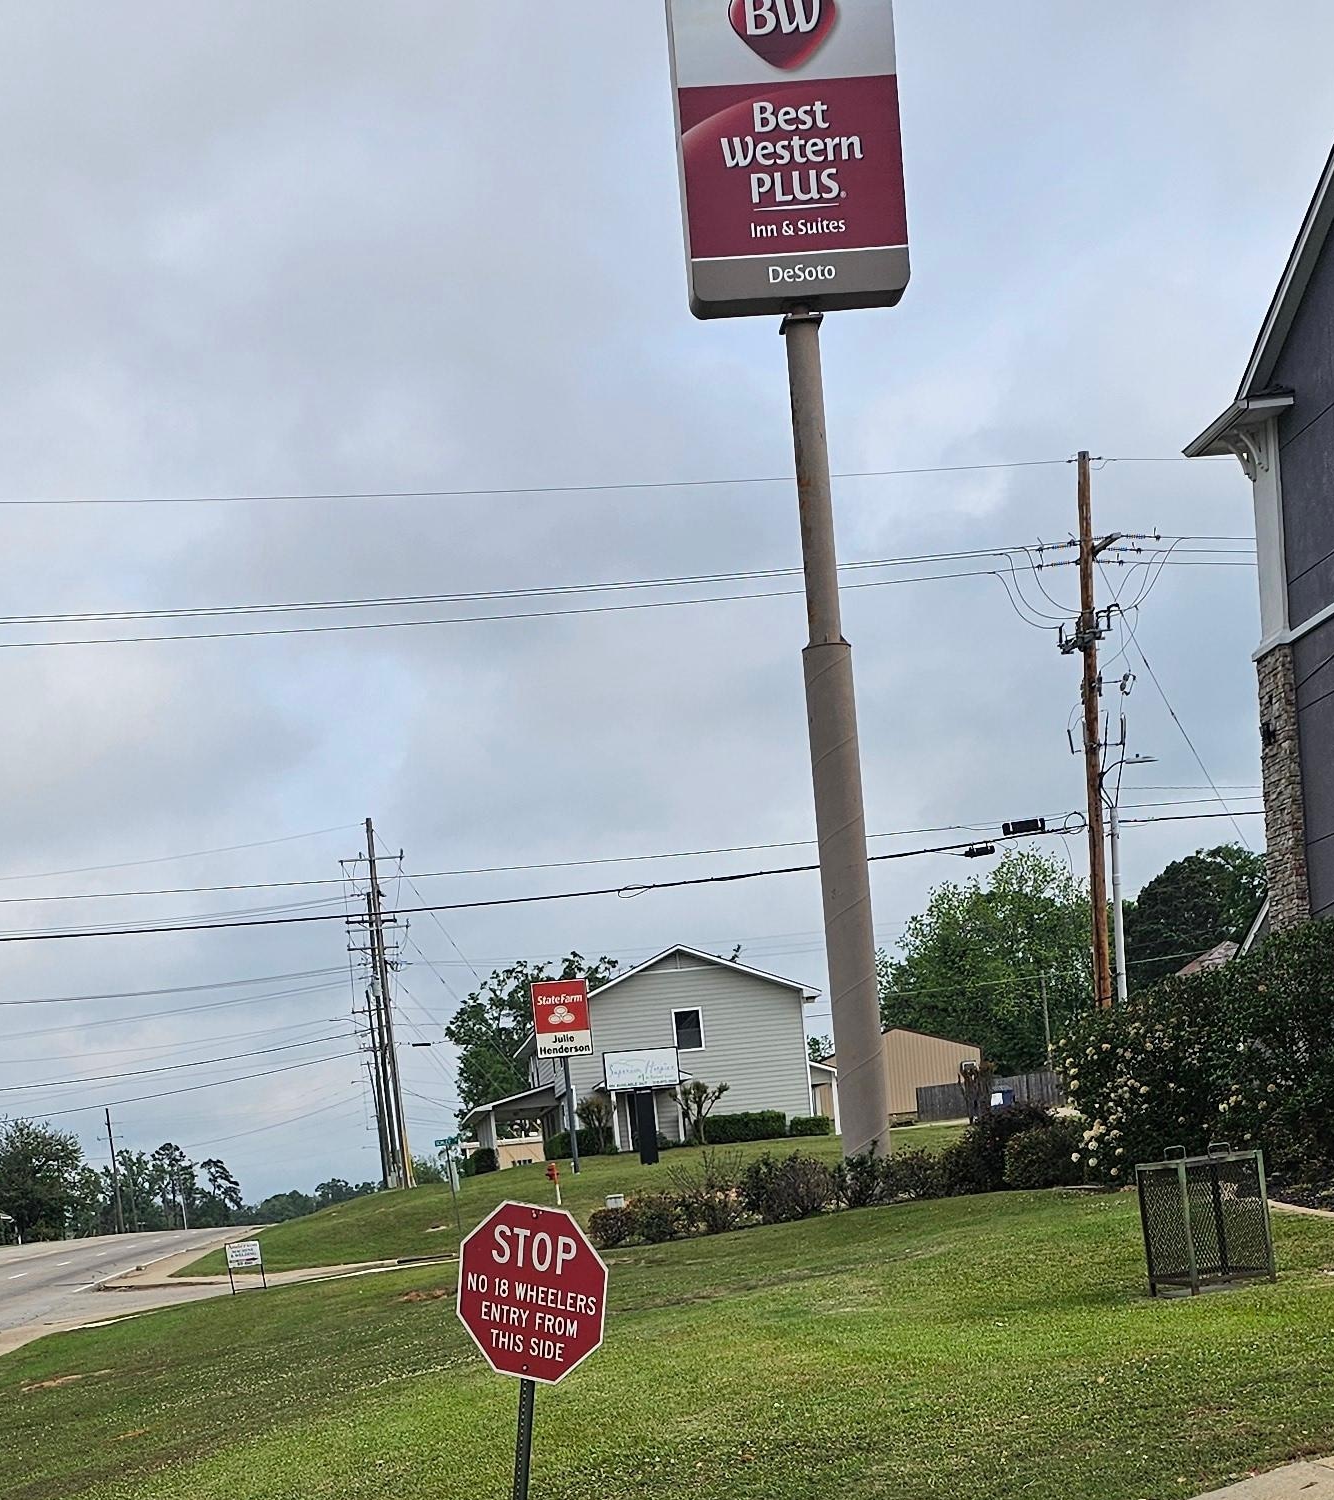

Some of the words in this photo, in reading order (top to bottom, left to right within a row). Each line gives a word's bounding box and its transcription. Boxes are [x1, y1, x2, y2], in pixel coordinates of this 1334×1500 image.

[745, 0, 821, 35] BW
[752, 101, 830, 133] Best
[720, 135, 863, 168] Western
[750, 168, 841, 203] PLUS
[750, 222, 778, 238] Inn
[782, 222, 794, 236] &
[797, 218, 846, 234] Suites
[768, 264, 836, 283] DeSoto
[539, 1044, 591, 1056] Henderson
[491, 1224, 577, 1275] STOP
[467, 1272, 488, 1293] NO
[494, 1278, 509, 1297] 18
[515, 1281, 597, 1316] WHEELERS
[481, 1301, 530, 1328] ENTRY
[535, 1312, 578, 1339] FROM
[490, 1328, 524, 1353] THIS
[529, 1337, 565, 1362] SIDE
